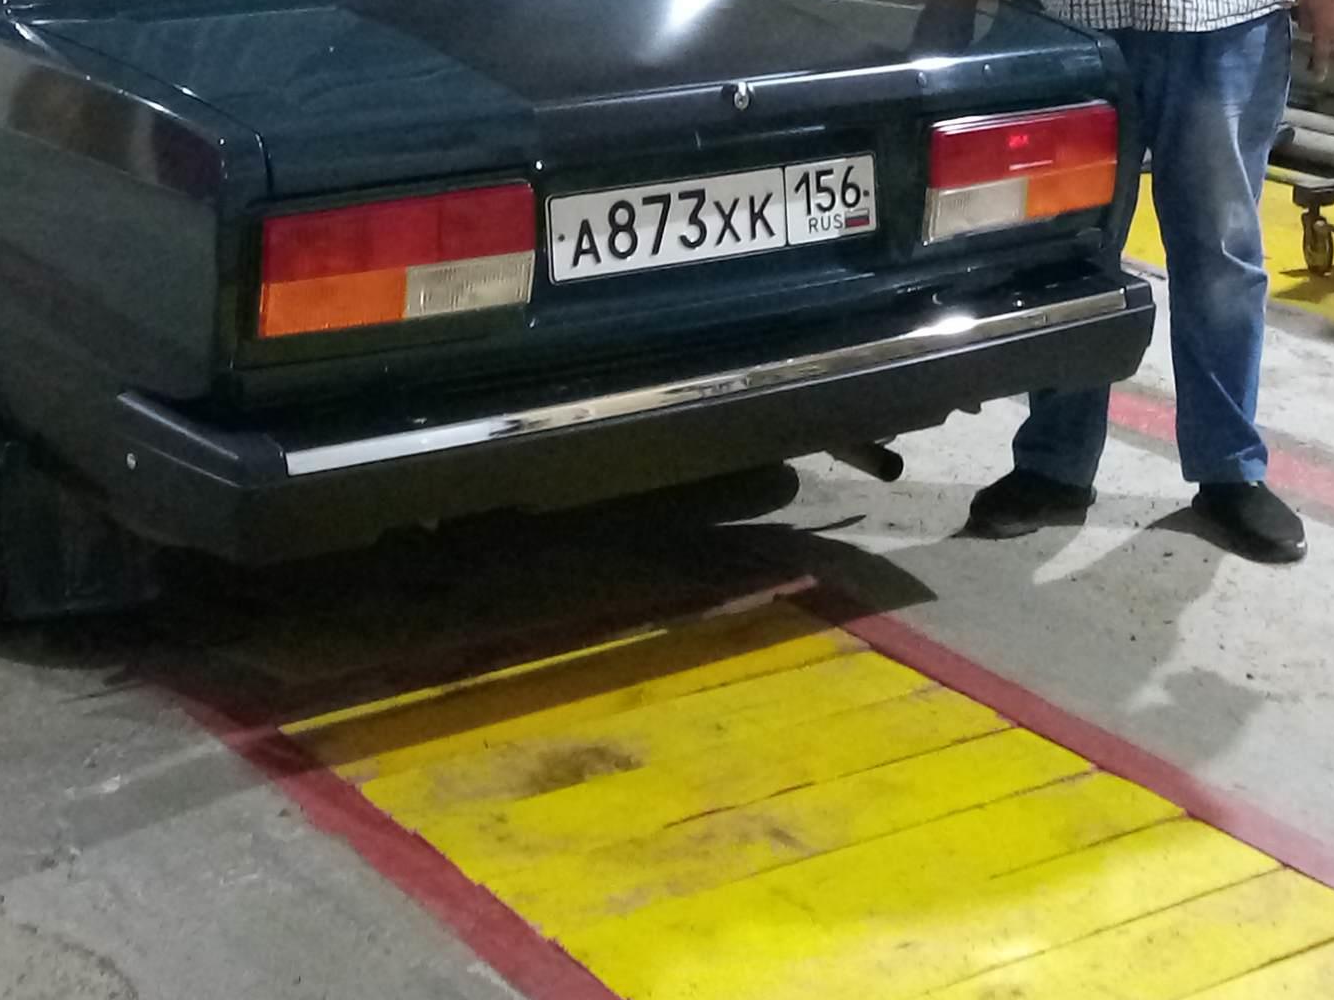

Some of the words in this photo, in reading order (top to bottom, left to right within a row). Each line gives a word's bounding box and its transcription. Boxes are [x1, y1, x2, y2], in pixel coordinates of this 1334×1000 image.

[570, 188, 776, 268] А873ХК
[793, 165, 862, 216] 156
[807, 215, 844, 235] RUS
